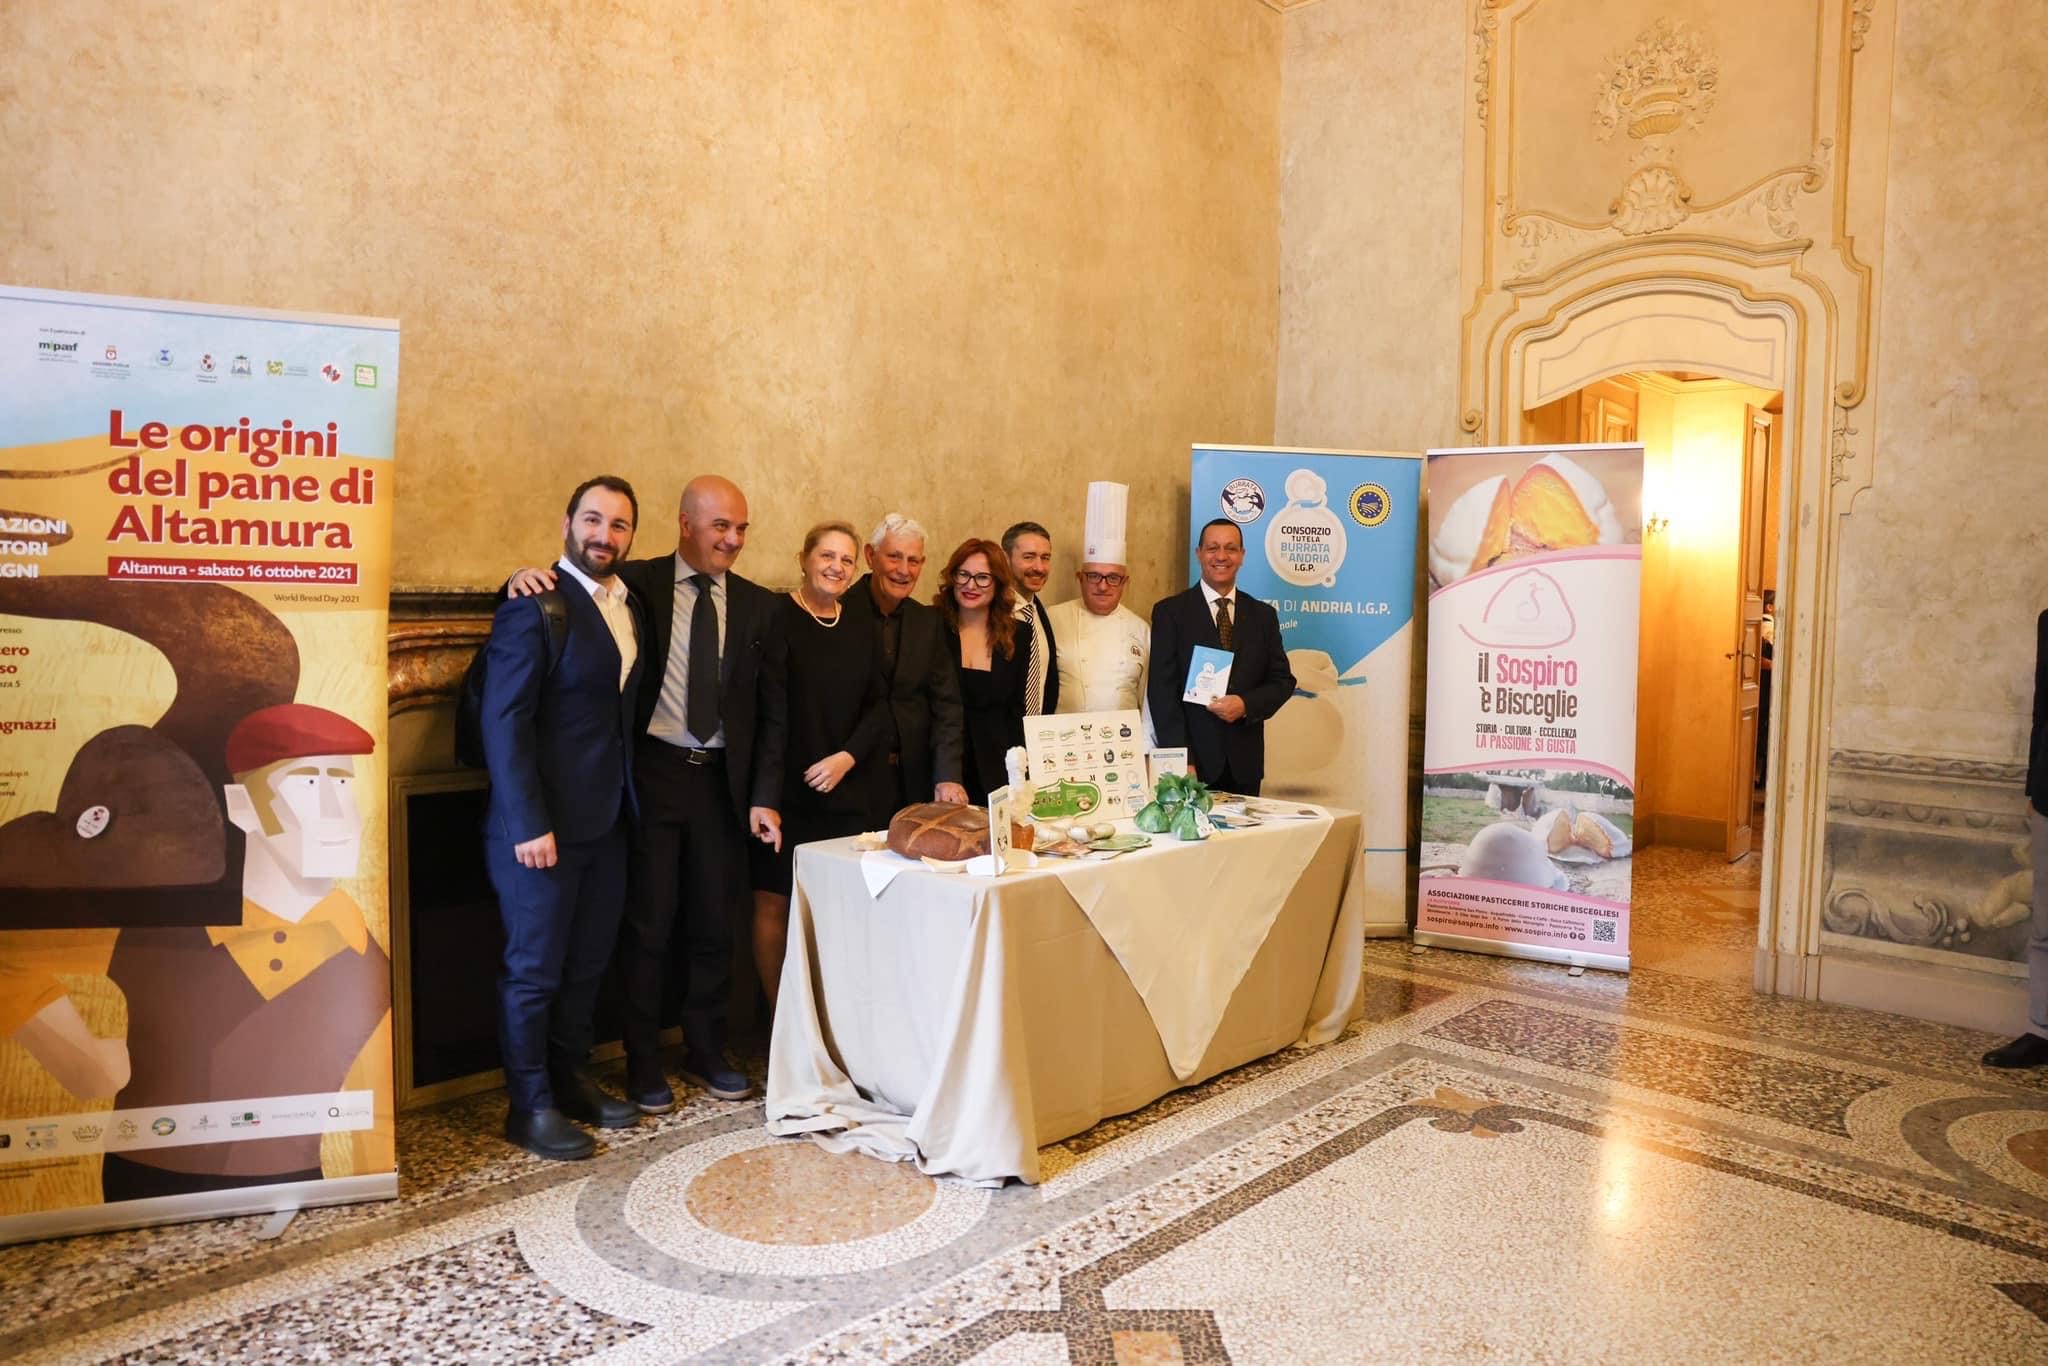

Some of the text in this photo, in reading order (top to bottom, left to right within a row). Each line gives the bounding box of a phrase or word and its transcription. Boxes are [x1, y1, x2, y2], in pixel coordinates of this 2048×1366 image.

[109, 409, 338, 467] Le origini
[107, 455, 374, 510] del pane di
[106, 503, 353, 549] Altamura
[1281, 525, 1331, 536] CONSORZIO
[1292, 535, 1321, 543] TUTELA
[1281, 542, 1330, 553] BURRATA
[1289, 552, 1330, 564] ANDRIA
[0, 563, 39, 579] GNI
[118, 561, 187, 577] Altamura
[197, 563, 245, 578] sabato
[247, 565, 262, 578] 16
[264, 565, 316, 580] ottobre
[318, 566, 352, 580] 2021
[1294, 563, 1315, 572] I.G.P.
[274, 593, 360, 605] World Bread Day 2021
[1284, 599, 1297, 612] DI
[1301, 600, 1353, 614] ANDRIA
[1357, 602, 1391, 615] I.G.P.
[0, 646, 30, 656] ero
[1478, 652, 1578, 691] il Sospiro
[1479, 686, 1578, 724] è Bisceglie
[1476, 723, 1577, 739] STORIA CULTURA ECCELLENZA
[1476, 734, 1576, 754] LA PASSIONE SI GUSTA
[1427, 889, 1480, 902] ASSOCIAZIONE
[1481, 895, 1530, 908] PASTICCERIE
[1531, 901, 1569, 912] STORICHE
[1570, 906, 1620, 918] BISCEGLIESI
